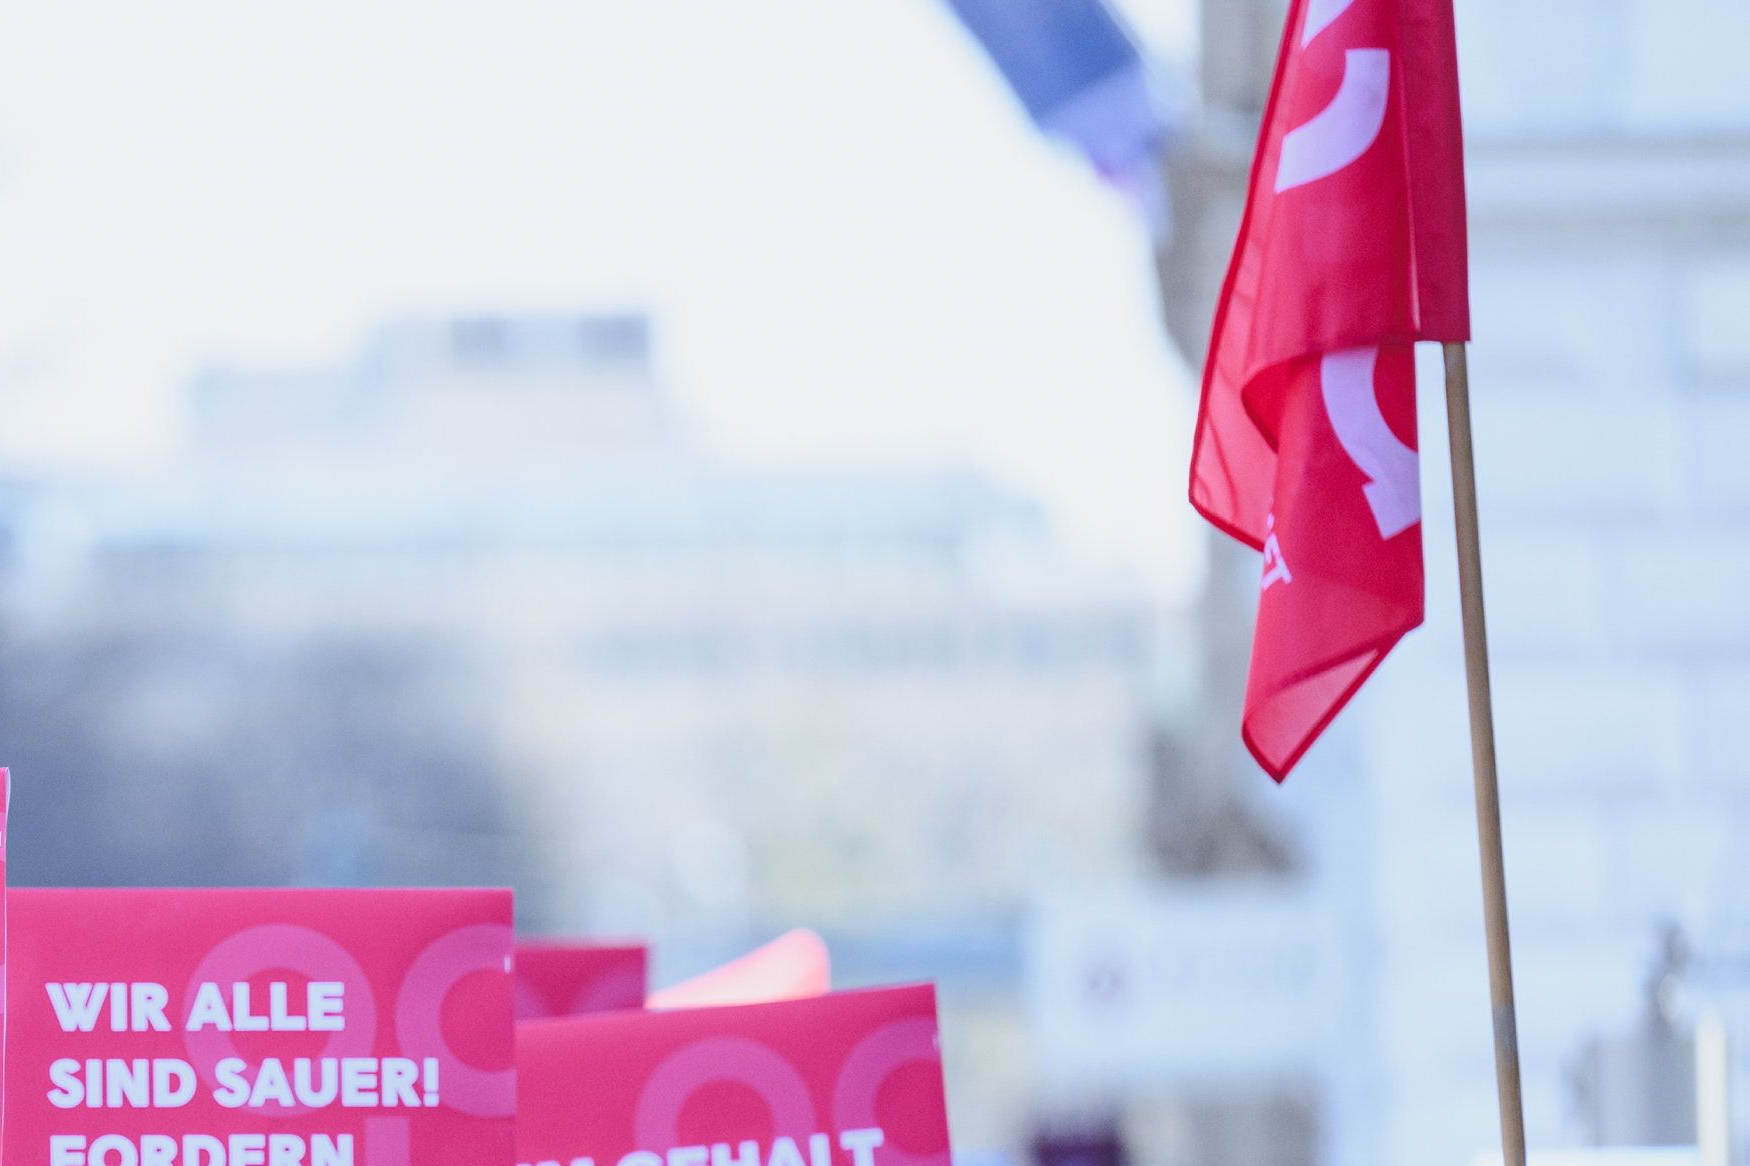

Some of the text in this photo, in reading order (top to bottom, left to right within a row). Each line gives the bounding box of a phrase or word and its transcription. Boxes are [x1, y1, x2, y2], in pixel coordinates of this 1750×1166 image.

[45, 981, 346, 1032] WIR ALLE
[46, 1057, 440, 1109] SIND SAUER!
